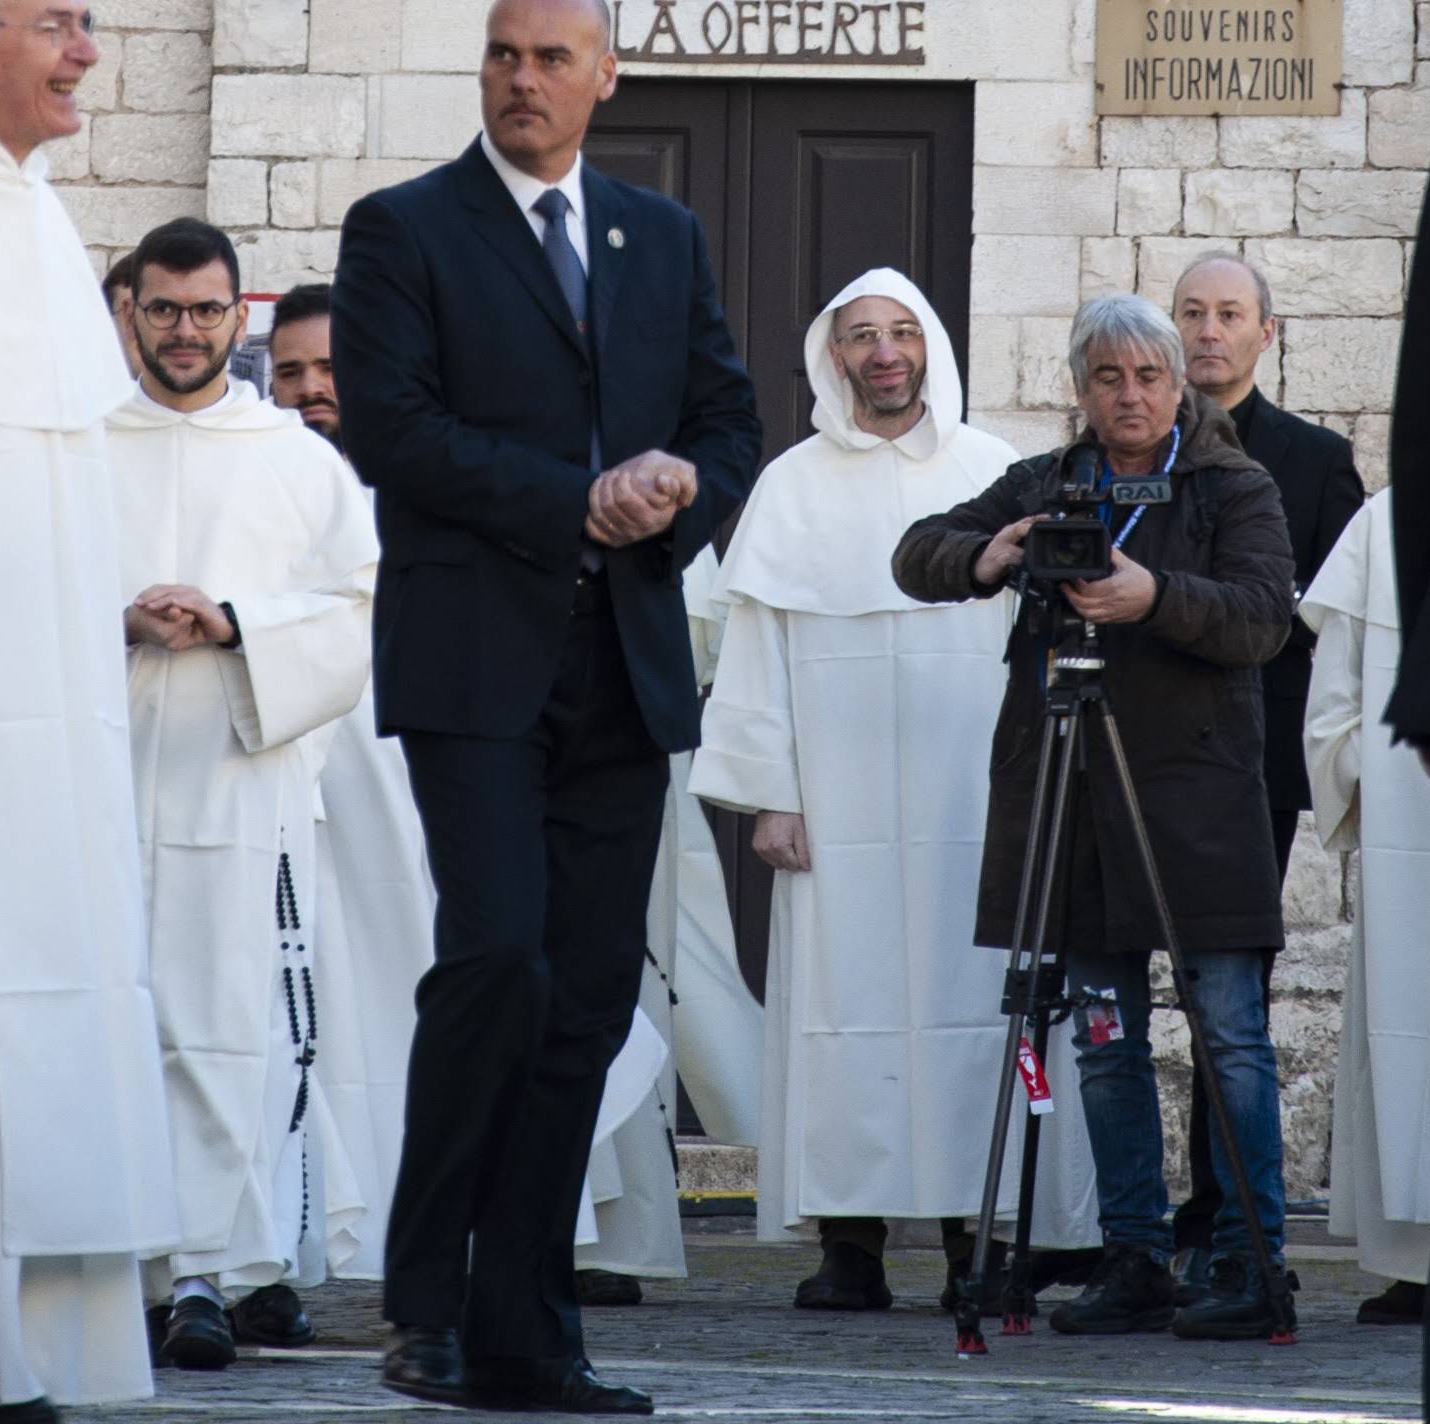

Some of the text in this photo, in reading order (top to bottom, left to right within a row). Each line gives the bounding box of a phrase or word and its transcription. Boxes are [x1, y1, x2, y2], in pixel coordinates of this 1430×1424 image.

[701, 0, 926, 58] OFFERTE
[1145, 9, 1294, 43] SOUVENIRS
[1124, 57, 1314, 102] INFORMAZIONI
[1116, 485, 1164, 502] RAI
